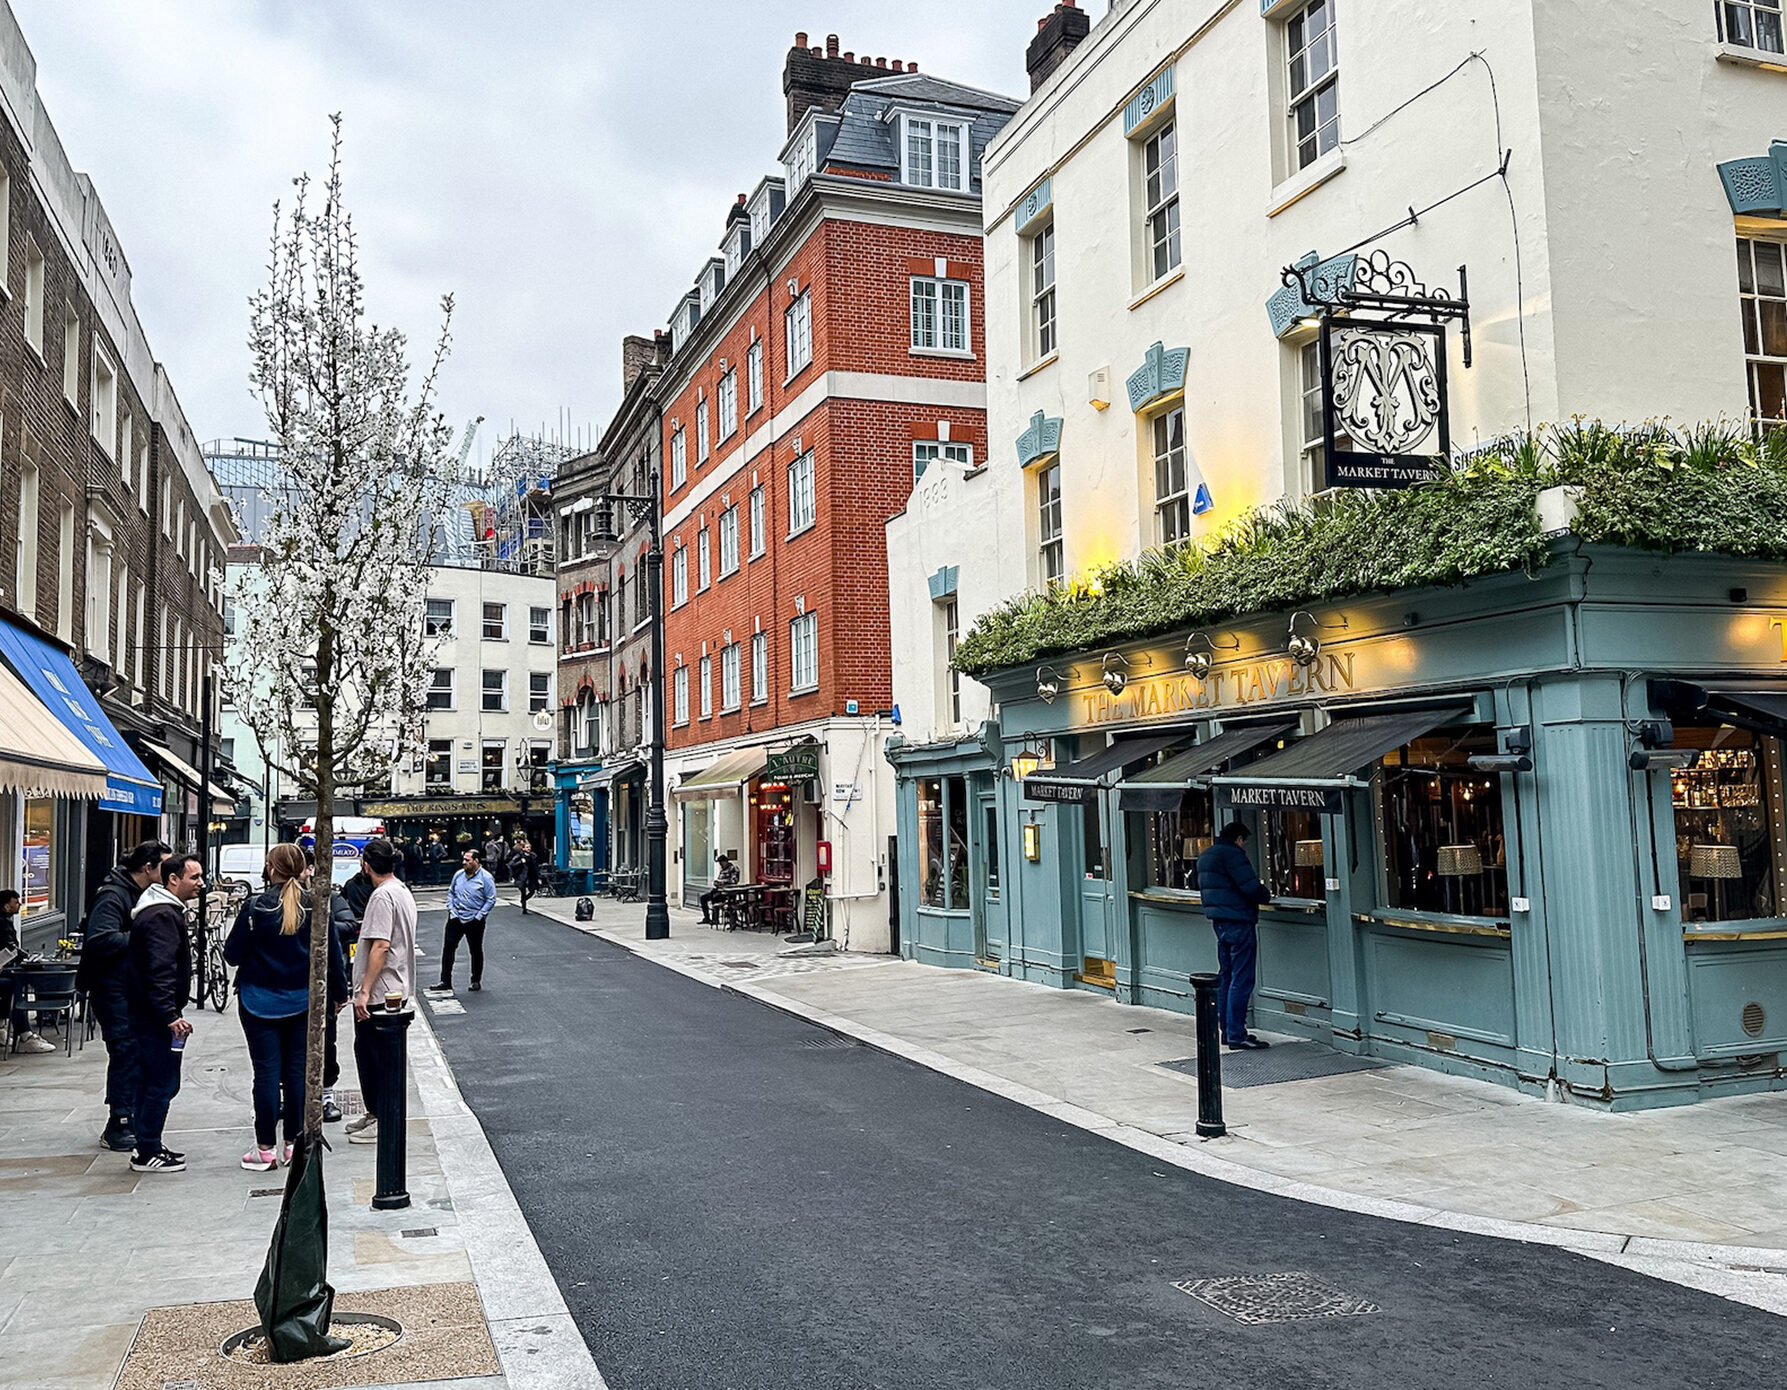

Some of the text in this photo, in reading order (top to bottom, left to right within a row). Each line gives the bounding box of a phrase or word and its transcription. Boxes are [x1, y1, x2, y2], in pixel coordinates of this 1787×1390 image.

[1380, 456, 1395, 465] THE
[1337, 464, 1440, 481] MARKET TAVERN
[1083, 652, 1354, 724] THE MARKET TAVERN
[1030, 784, 1084, 800] MARKET TAVERN
[1231, 788, 1326, 807] MARKET TAVERN
[407, 802, 424, 813] THE
